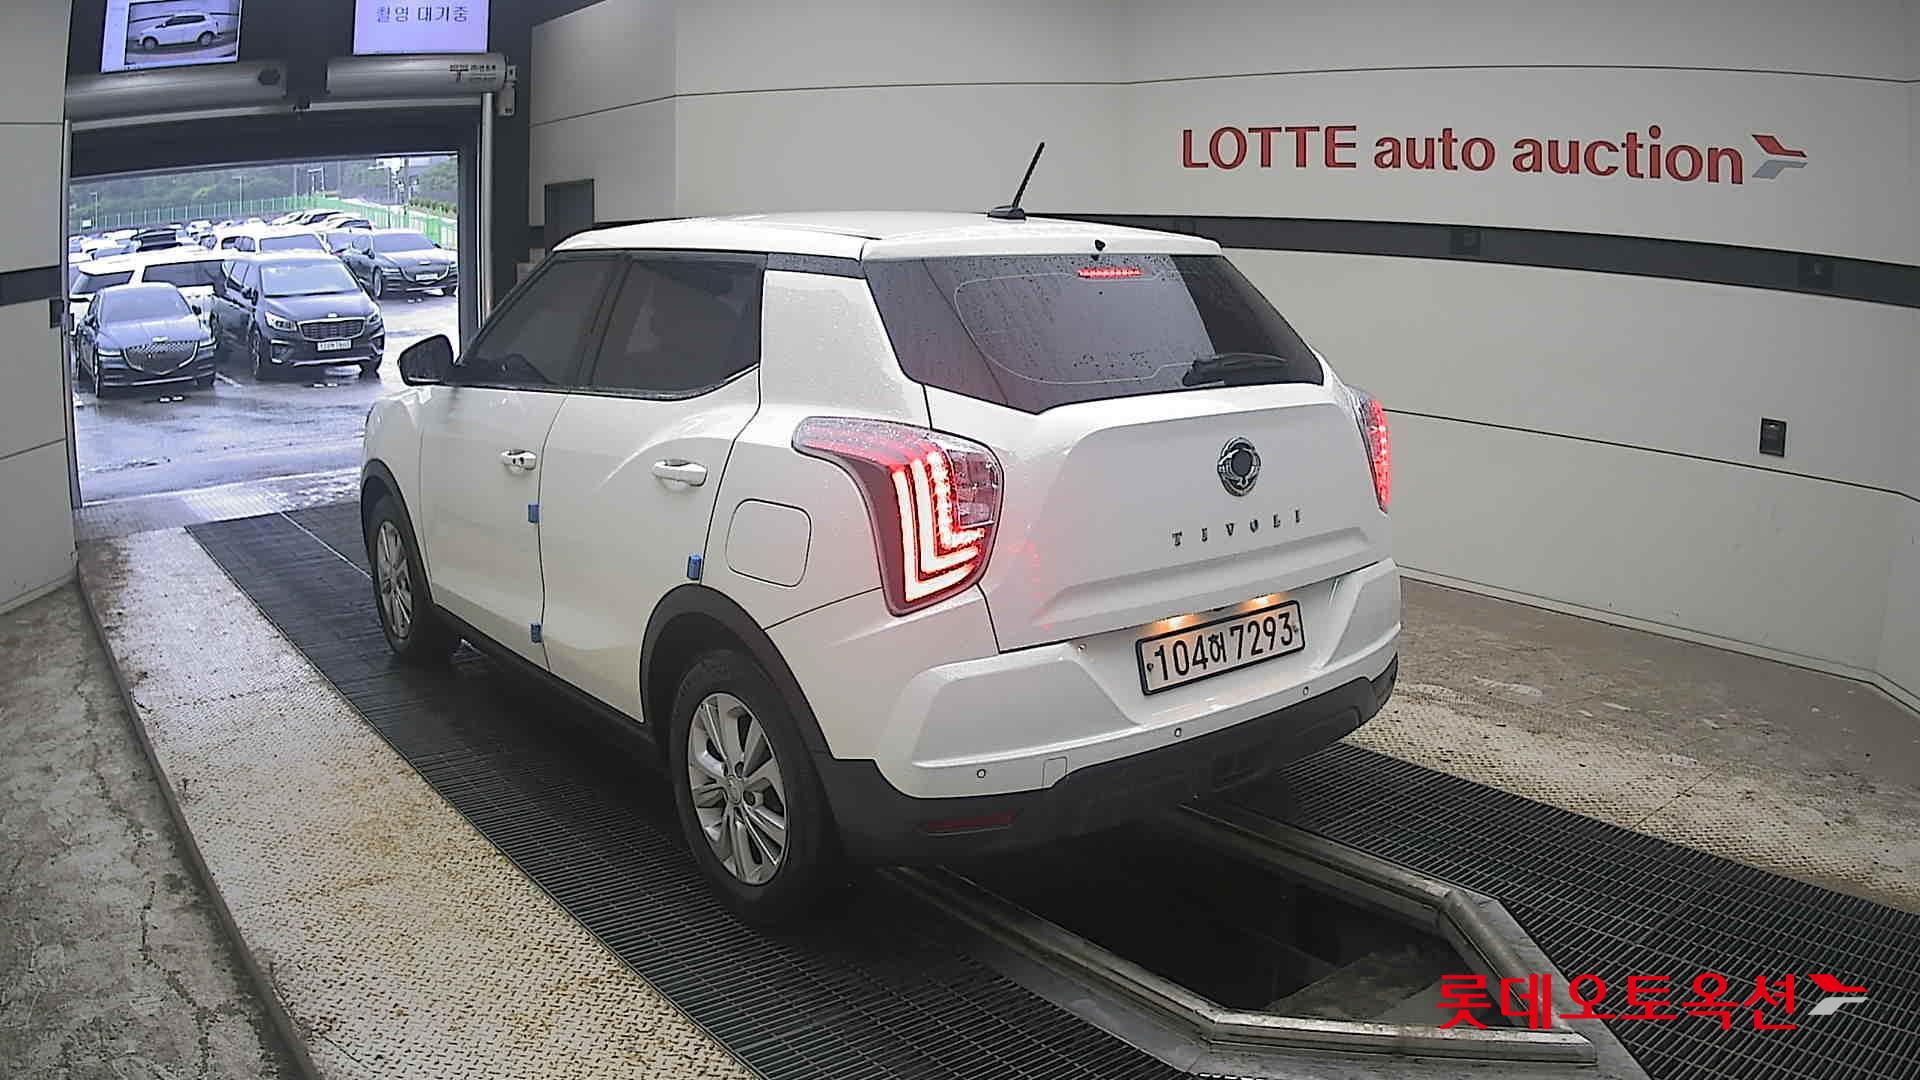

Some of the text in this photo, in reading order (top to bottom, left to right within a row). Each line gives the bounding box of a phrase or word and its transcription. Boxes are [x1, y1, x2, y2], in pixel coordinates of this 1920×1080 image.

[417, 5, 469, 23] 대기중
[1183, 125, 1745, 183] LOTTE auto auction
[1171, 509, 1300, 547] TIVOLI
